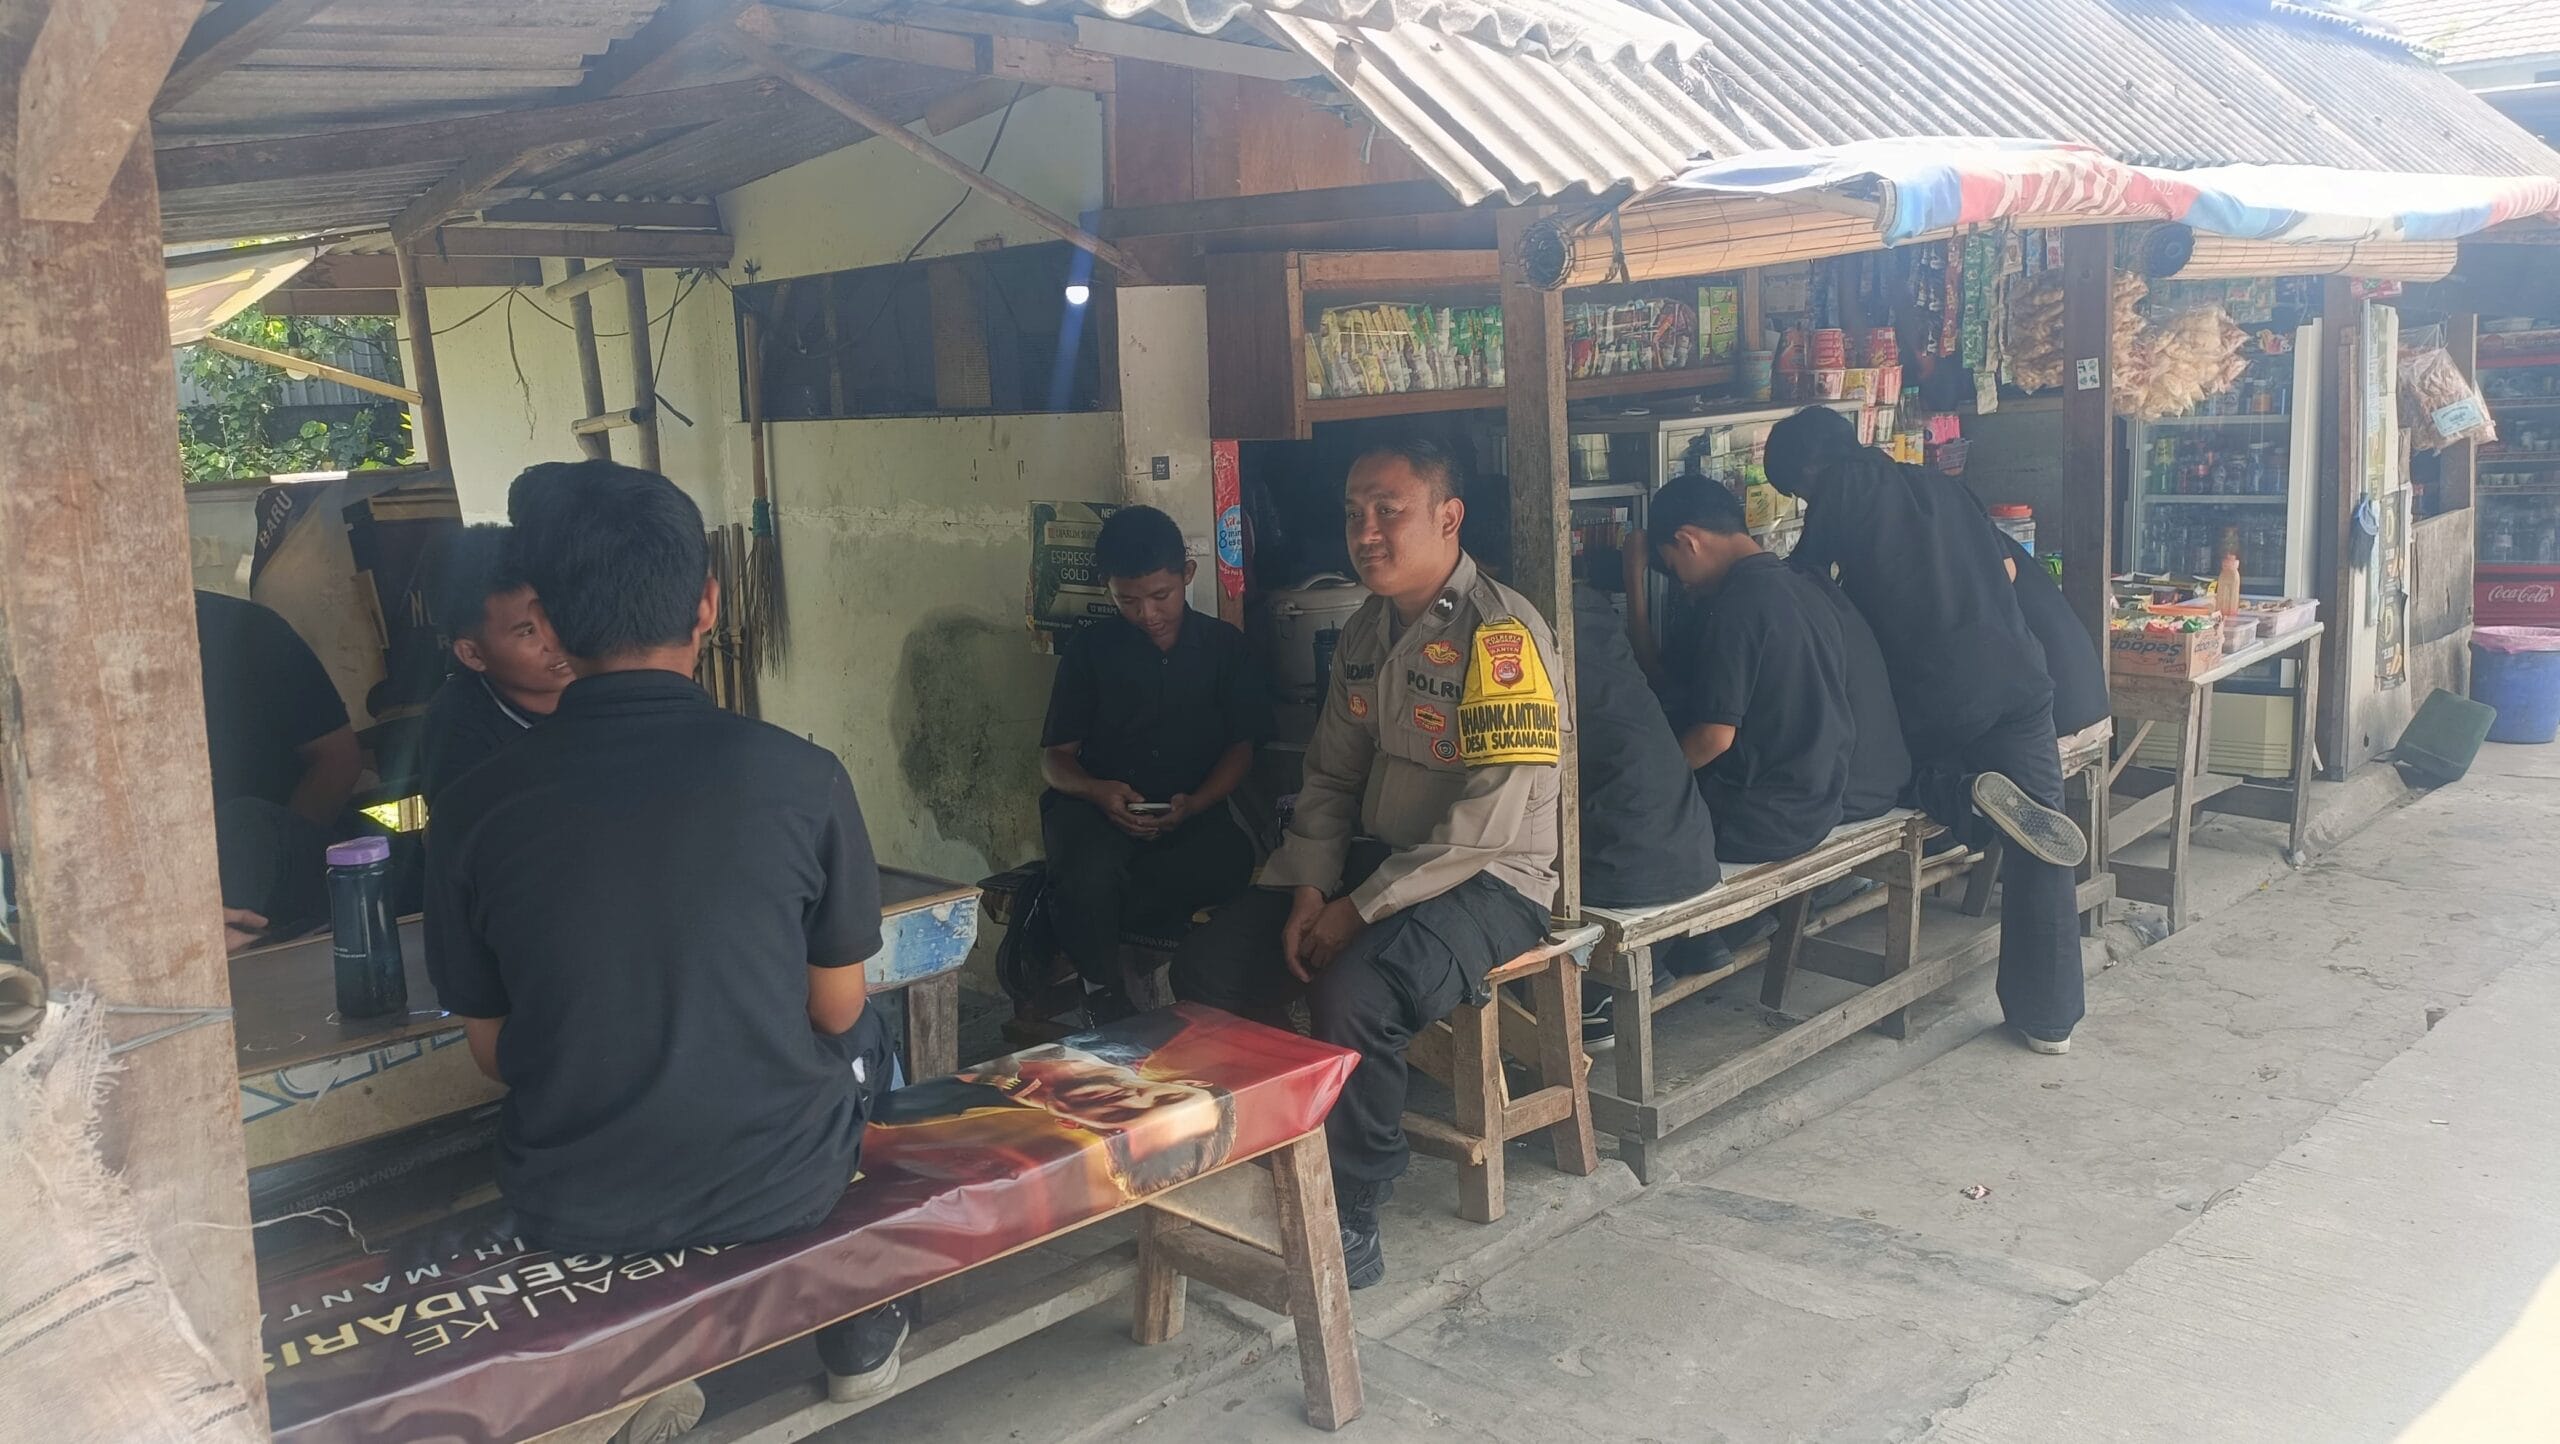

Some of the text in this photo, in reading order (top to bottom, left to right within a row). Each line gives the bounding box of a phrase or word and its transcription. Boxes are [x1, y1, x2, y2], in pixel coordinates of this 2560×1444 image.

[258, 490, 294, 549] BARU
[1051, 550, 1098, 567] ESPRESSO
[1060, 568, 1090, 582] GOLD
[1407, 670, 1462, 699] POLRI
[1465, 731, 1558, 754] DESA SUKANAGARA
[258, 1261, 443, 1323] MANT
[411, 1241, 746, 1358] MBALI KE
[262, 1250, 640, 1379] GENDARIS
